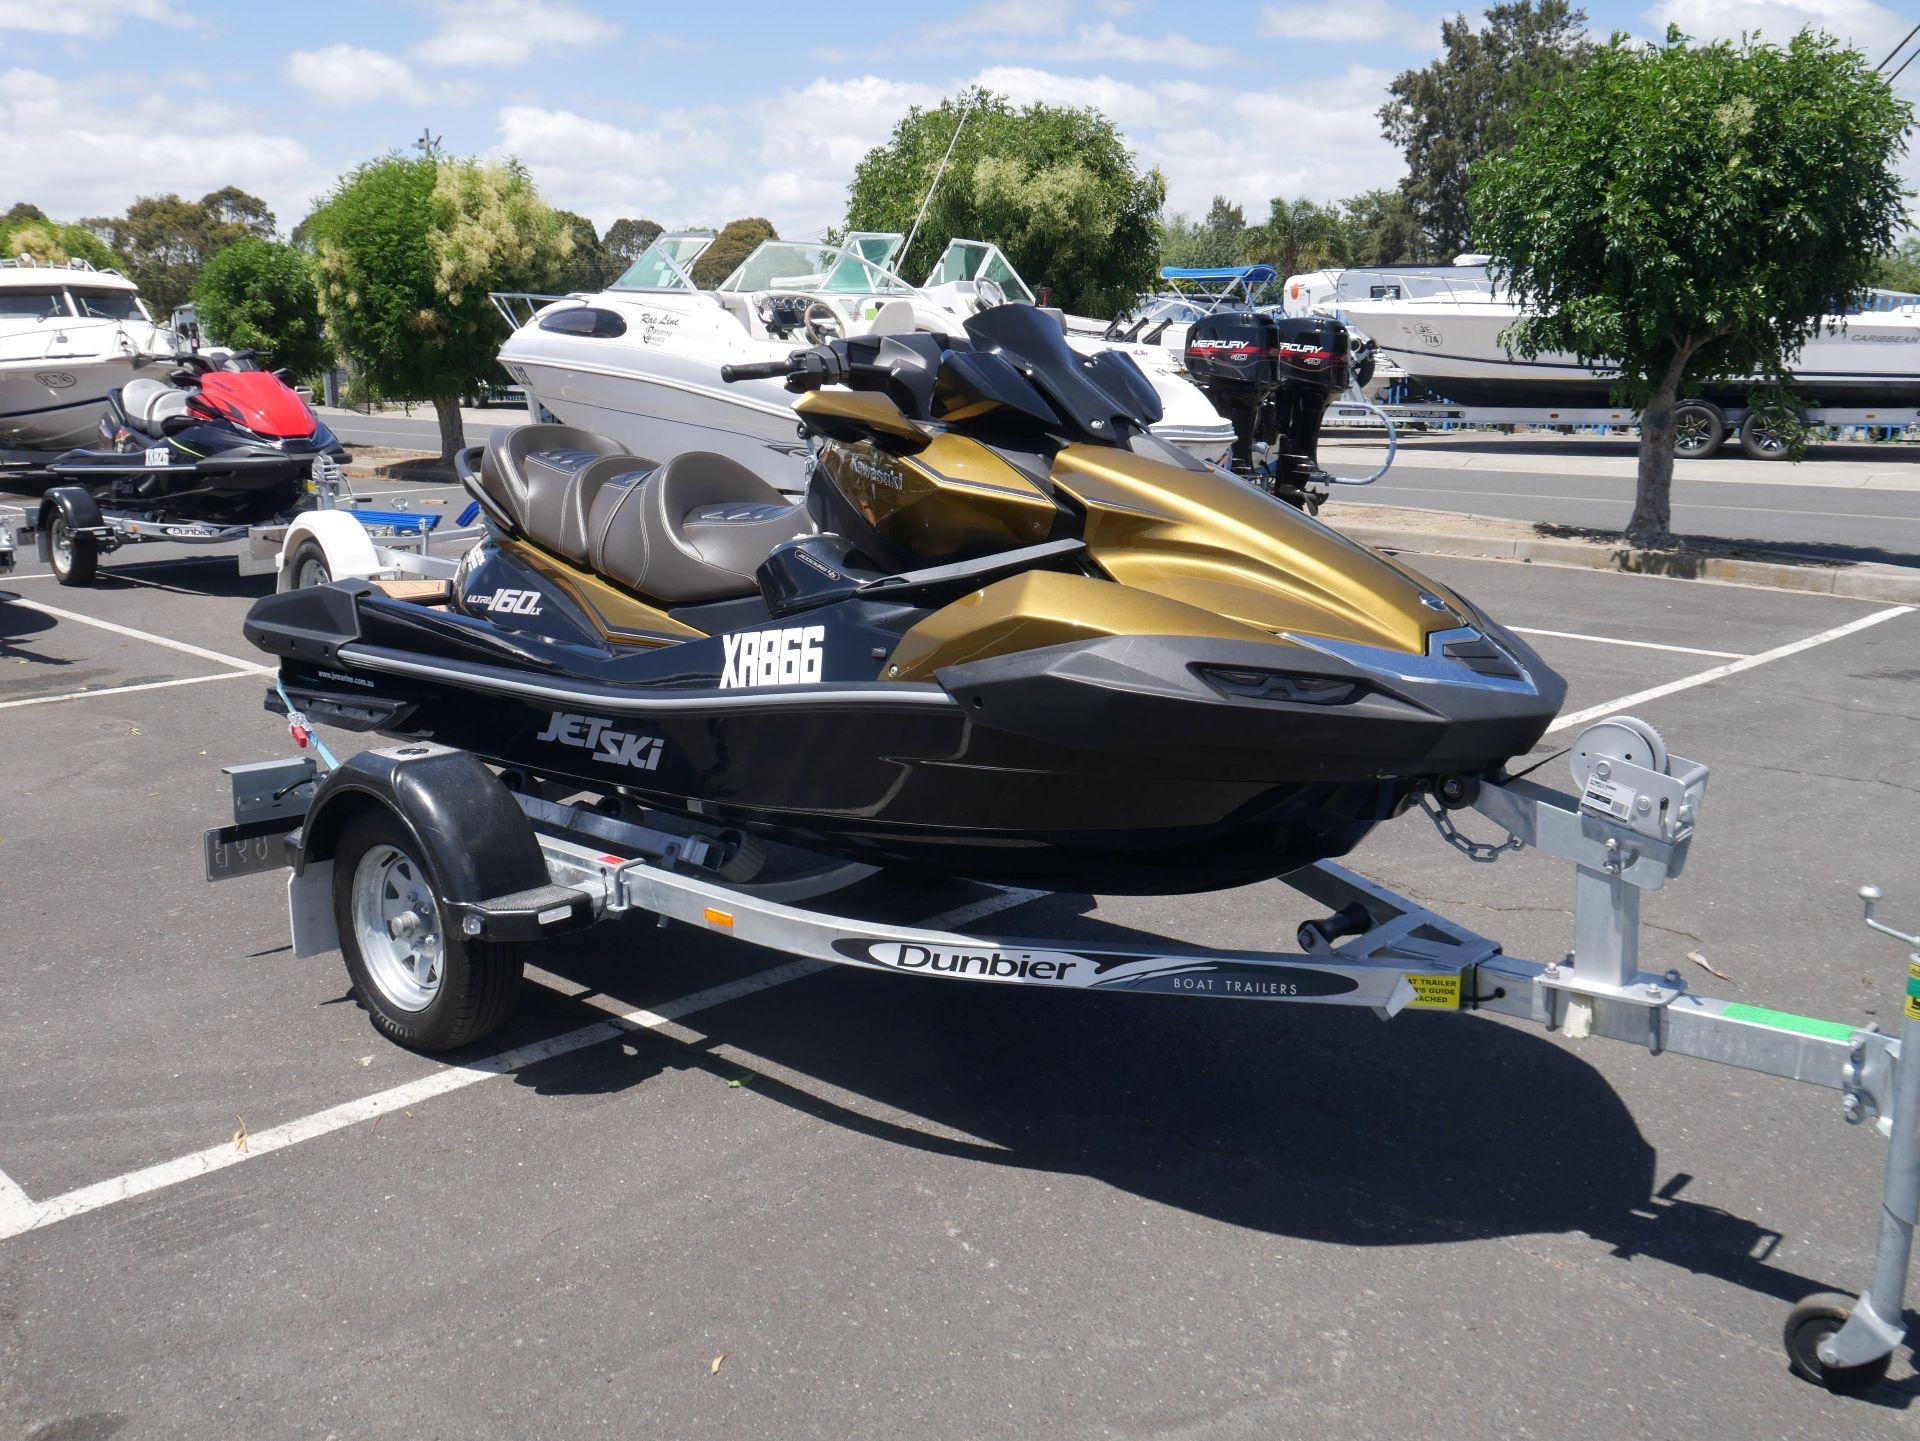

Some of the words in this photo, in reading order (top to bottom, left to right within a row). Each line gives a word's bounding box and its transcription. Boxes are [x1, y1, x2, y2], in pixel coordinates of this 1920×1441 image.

[641, 313, 658, 324] Rae
[658, 314, 680, 326] Line
[1191, 339, 1249, 349] MERCURY
[1851, 334, 1919, 344] CARIBBEAN
[1280, 342, 1323, 353] RCURY
[1231, 353, 1248, 361] 40
[1304, 357, 1322, 366] 40
[850, 454, 903, 491] Kawasaki
[172, 527, 214, 536] Dunbier
[466, 594, 492, 604] ULTRA
[487, 588, 542, 615] 160
[529, 606, 543, 616] LX
[719, 625, 825, 690] XA866
[536, 711, 613, 749] JET
[896, 944, 1077, 981] Dunbier
[1173, 978, 1214, 990] BOAT
[1225, 980, 1297, 995] TRAILERS
[1421, 979, 1457, 987] TRAILER
[1415, 995, 1448, 1003] ACHED
